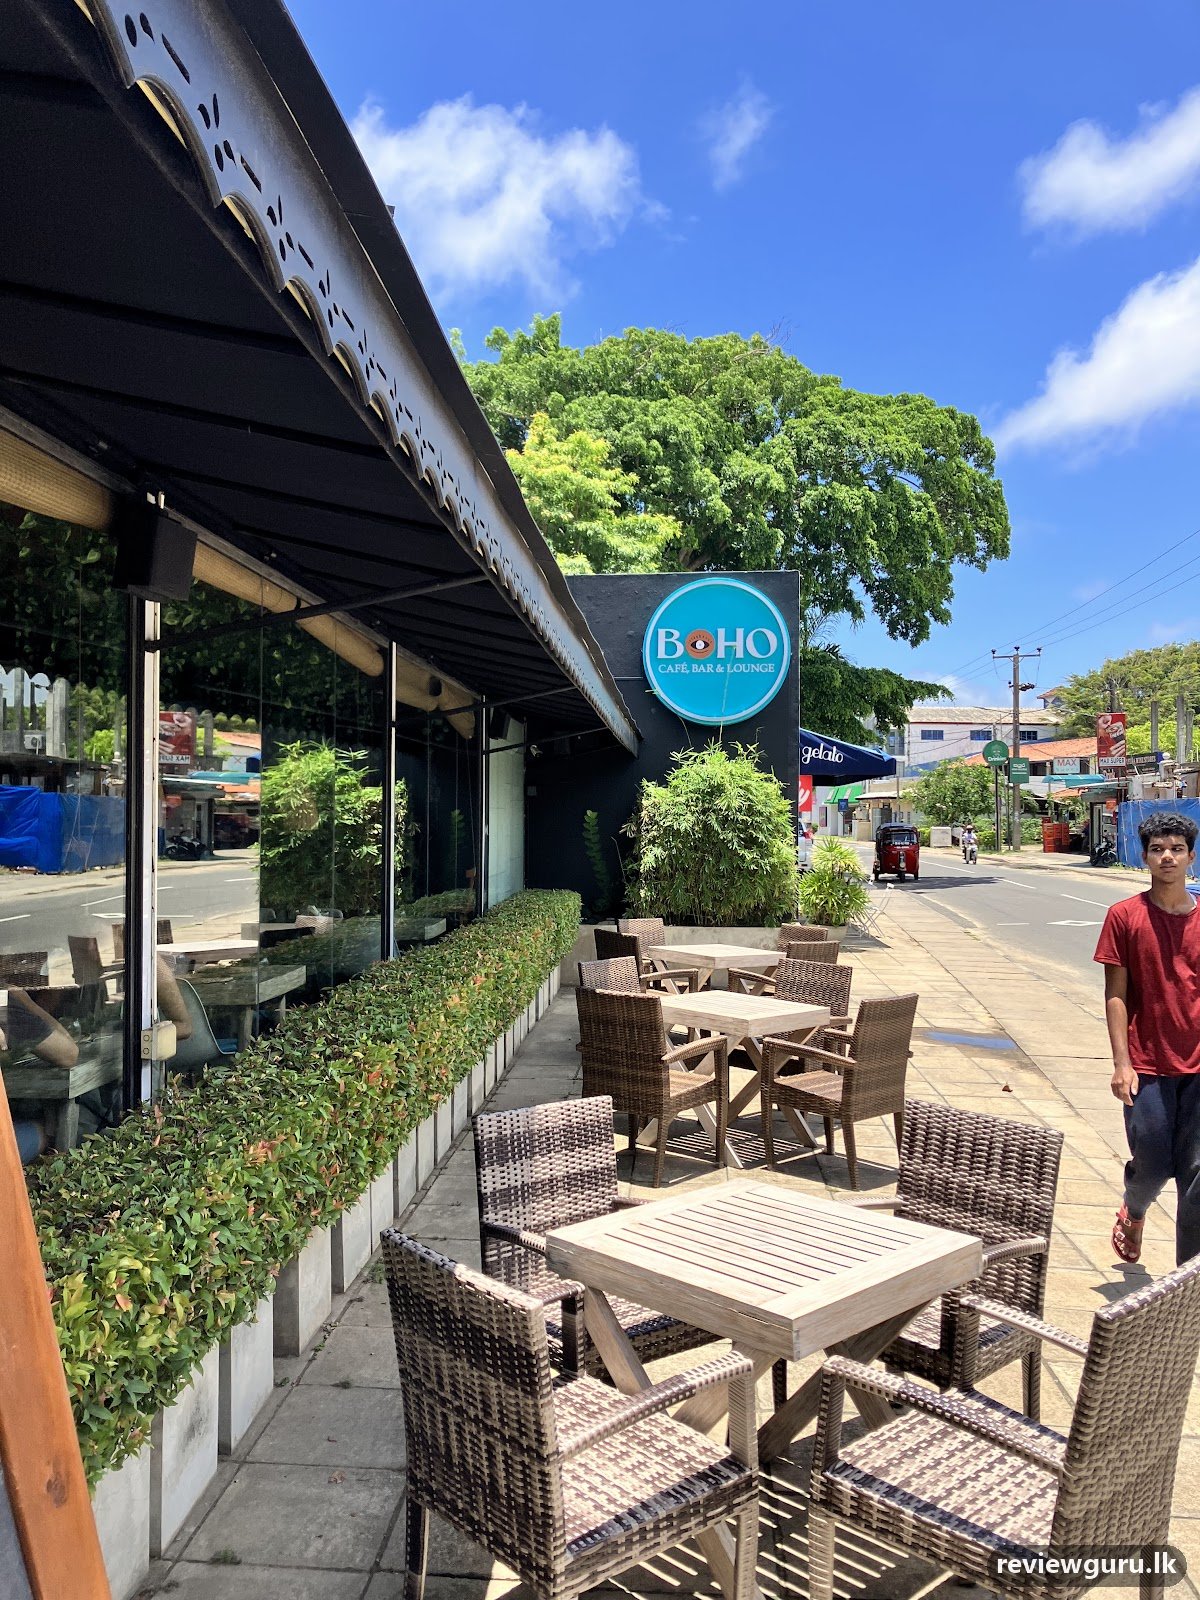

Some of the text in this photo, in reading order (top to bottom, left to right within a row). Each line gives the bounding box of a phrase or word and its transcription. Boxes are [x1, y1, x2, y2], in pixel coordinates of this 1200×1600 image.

[657, 627, 778, 659] BOHO
[691, 663, 714, 673] BAR
[715, 663, 724, 673] &
[727, 663, 775, 673] LOUNGE
[802, 743, 844, 765] gelato
[1057, 758, 1078, 766] MAX
